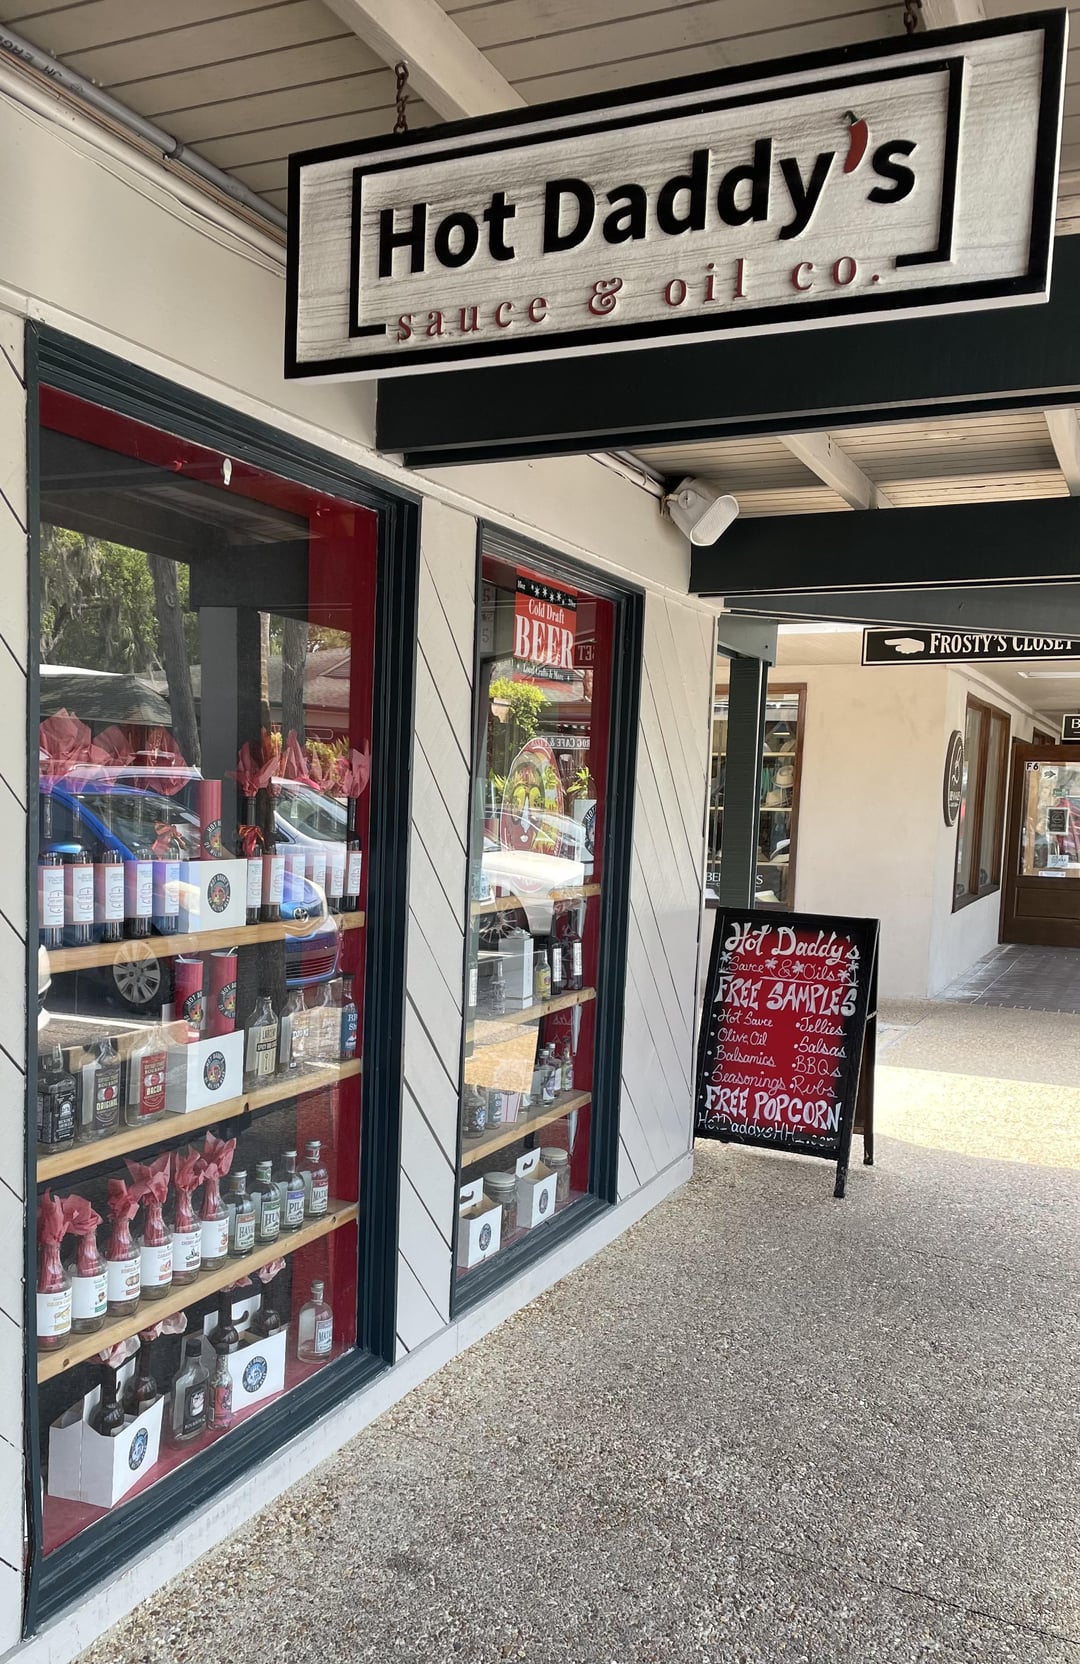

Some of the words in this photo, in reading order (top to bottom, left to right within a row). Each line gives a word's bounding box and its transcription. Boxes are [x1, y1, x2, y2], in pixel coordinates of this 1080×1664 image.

[0, 35, 34, 61] EAG
[379, 200, 516, 278] Hot
[542, 111, 918, 253] Daddy's
[396, 297, 549, 342] sauce
[588, 277, 623, 315] &
[664, 258, 745, 307] oil
[791, 254, 882, 291] co.
[528, 598, 545, 618] Cold
[547, 603, 565, 624] Draft
[513, 614, 575, 669] BEER
[929, 633, 1007, 654] FROSTY'S
[1012, 636, 1073, 651] CLOSET
[724, 922, 772, 955] Hot
[771, 926, 861, 966] Daddy's
[727, 956, 764, 974] Sauce
[777, 958, 793, 978] &
[803, 963, 840, 981] Oils
[714, 974, 762, 1011] FREE
[766, 982, 859, 1017] SAMPLES
[717, 1008, 743, 1024] Hot
[743, 1010, 774, 1028] Sauce
[799, 1015, 847, 1037] Jellies
[717, 1028, 749, 1045] Olive
[749, 1031, 768, 1046] Oil
[798, 1036, 847, 1059] Salsas
[714, 1045, 777, 1068] Balsamics
[794, 1055, 842, 1078] BBQs
[711, 1064, 787, 1096] Seasonings
[792, 1075, 838, 1098] Rubs
[704, 1084, 749, 1118] FREE
[753, 1091, 842, 1133] POPCORN
